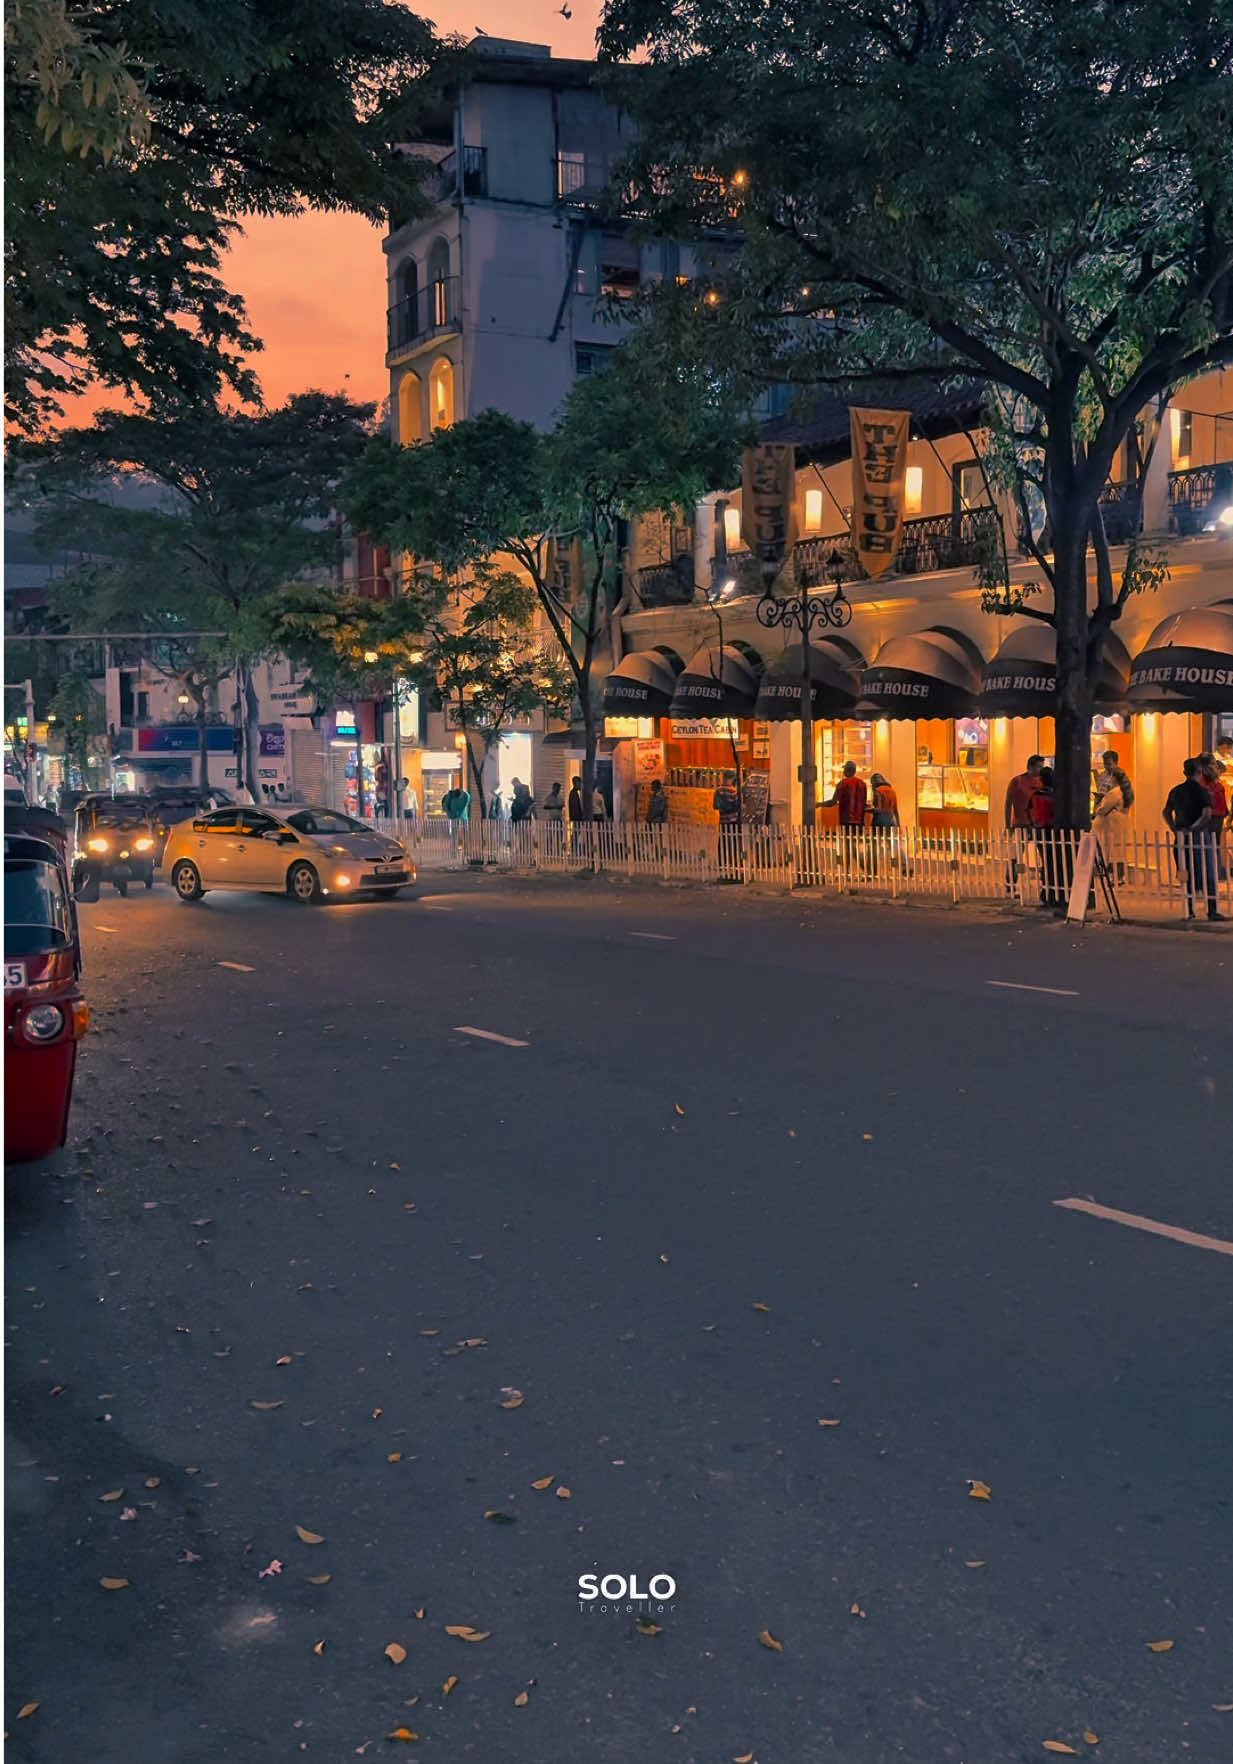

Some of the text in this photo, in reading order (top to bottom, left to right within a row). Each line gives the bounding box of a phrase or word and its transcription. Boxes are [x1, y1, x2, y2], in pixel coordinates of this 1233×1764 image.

[1139, 667, 1172, 685] BAKE
[883, 682, 928, 697] HOUSE
[1012, 676, 1057, 693] HOUS
[615, 687, 648, 701] HOUSE
[778, 686, 817, 701] HOUE
[671, 725, 698, 735] CEYLON
[698, 724, 713, 735] TEA
